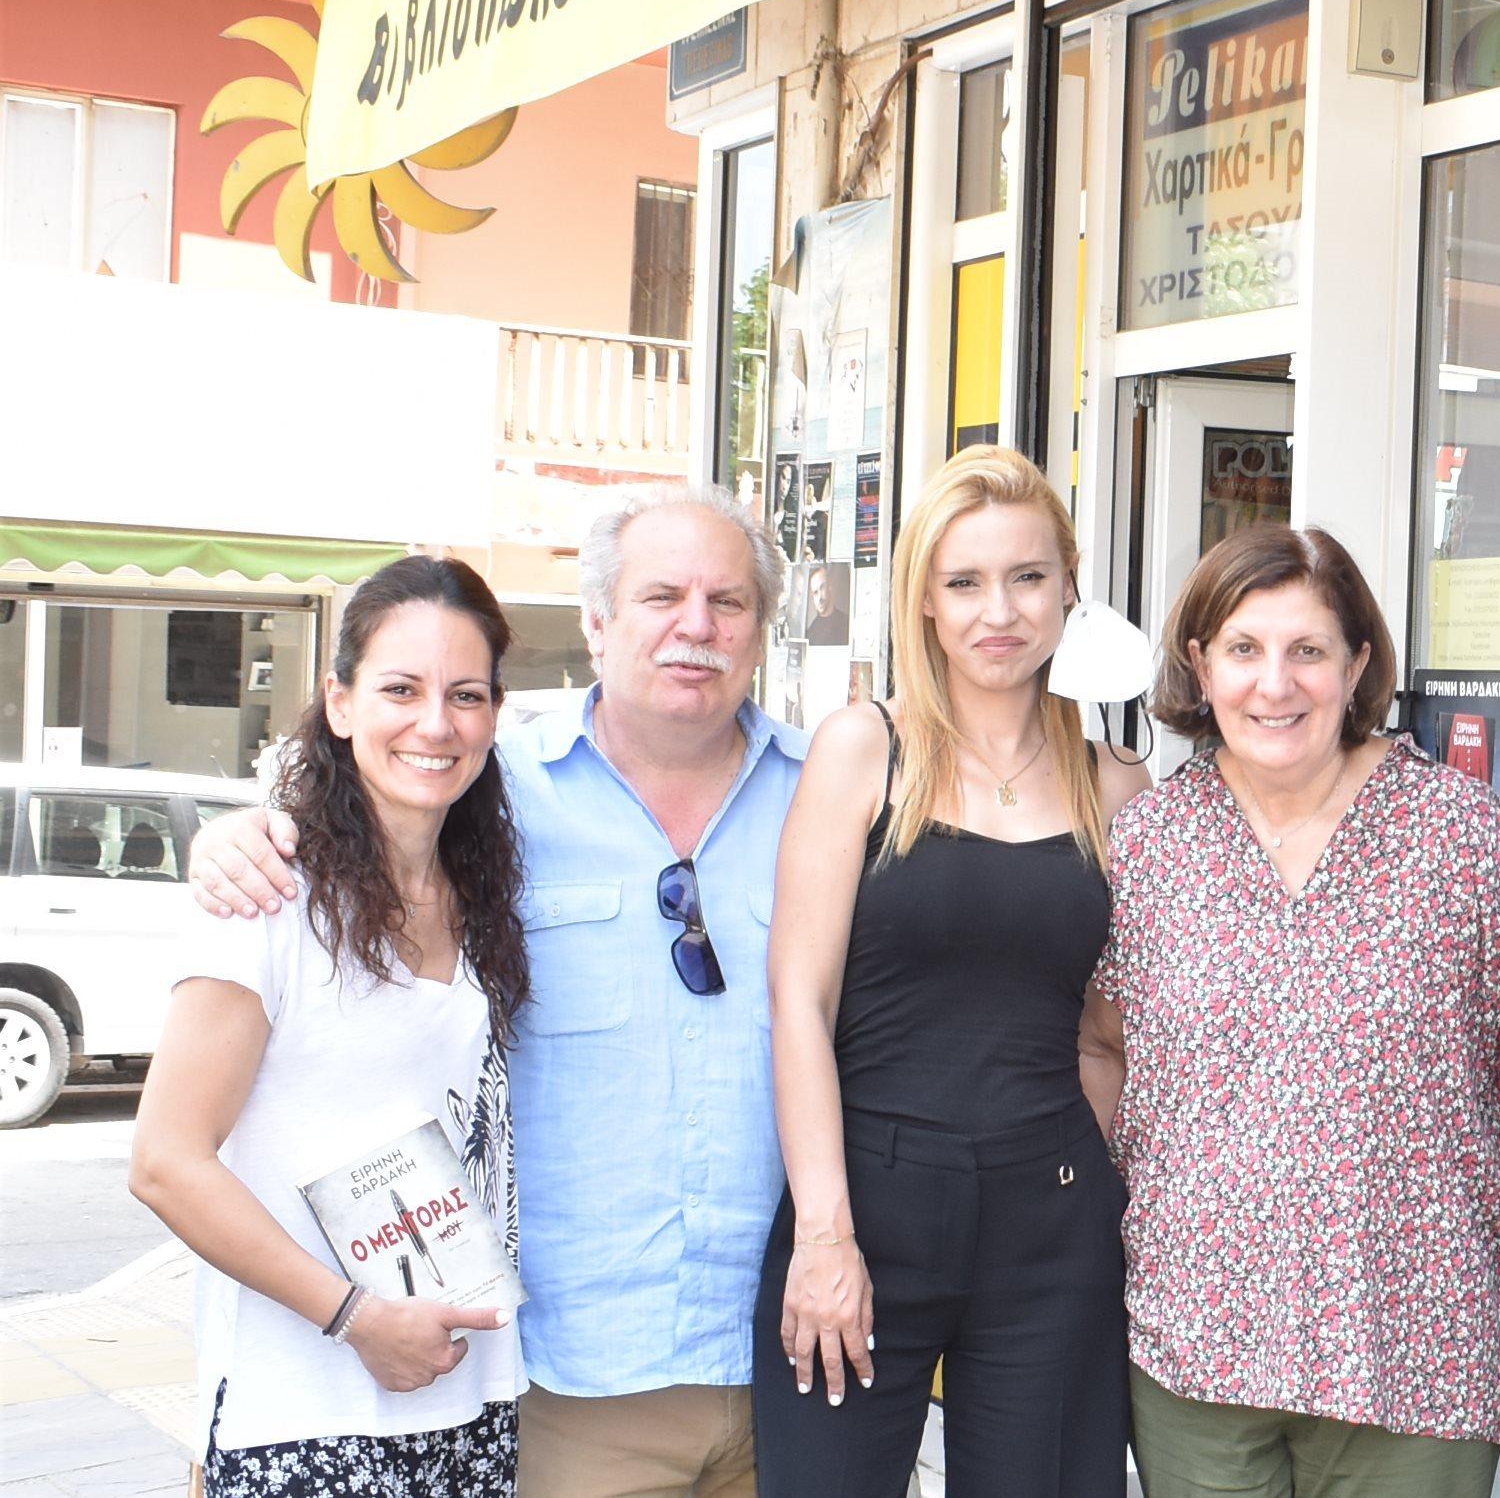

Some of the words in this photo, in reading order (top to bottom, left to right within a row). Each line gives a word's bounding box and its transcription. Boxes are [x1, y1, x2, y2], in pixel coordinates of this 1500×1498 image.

[1425, 680, 1458, 696] ΕΙΡΗΝΗ
[350, 1148, 404, 1183] ΕΙΡΗΝΗ
[350, 1159, 417, 1201] ΒΑΡΔΑΚΗ
[350, 1239, 369, 1262] Ο
[370, 1187, 469, 1255] ΜΕΝΤΟΡΑΣ
